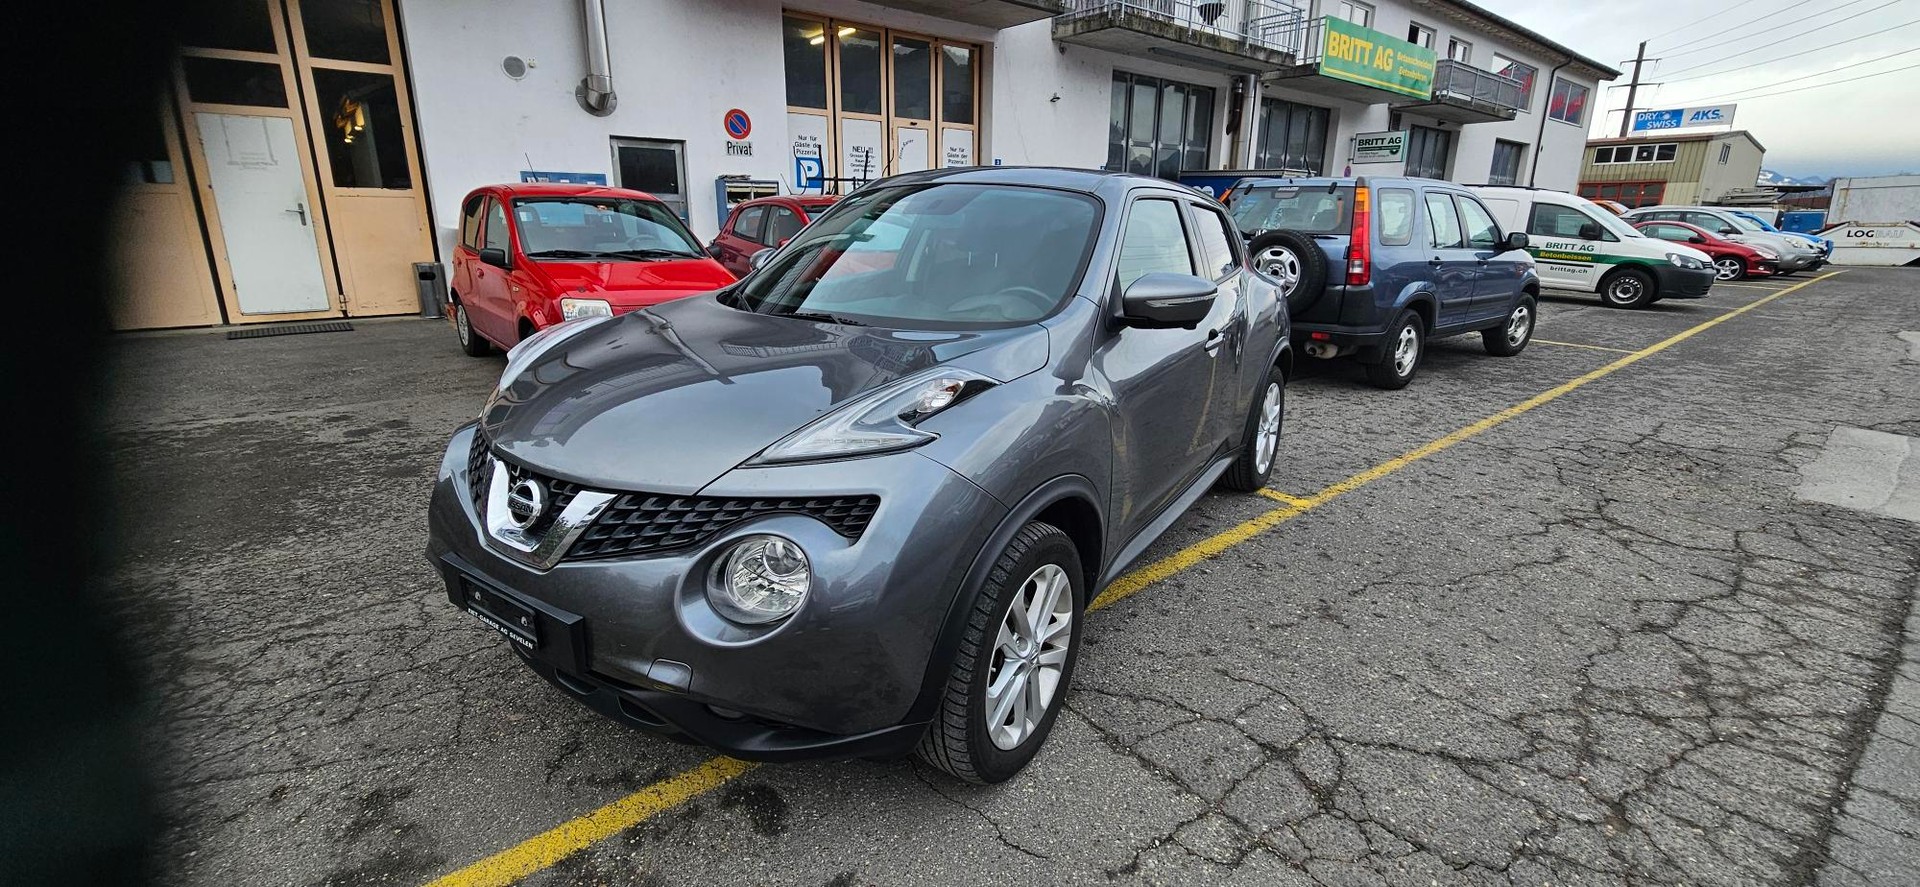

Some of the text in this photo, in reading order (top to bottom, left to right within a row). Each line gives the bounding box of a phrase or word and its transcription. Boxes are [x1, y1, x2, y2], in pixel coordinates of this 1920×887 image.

[1327, 30, 1394, 72] BRITT AG
[1638, 112, 1659, 121] DRY
[1690, 109, 1720, 121] AKS
[1647, 120, 1677, 129] SWISS
[1358, 136, 1402, 146] BRITT AG
[726, 140, 753, 156] Privat
[796, 148, 817, 156] Pizzeria
[800, 160, 819, 187] P
[1545, 242, 1595, 252] BRITT AG
[1540, 251, 1592, 261] Betonbeissen
[1550, 266, 1588, 274] brittag.ch
[500, 626, 508, 636] AG
